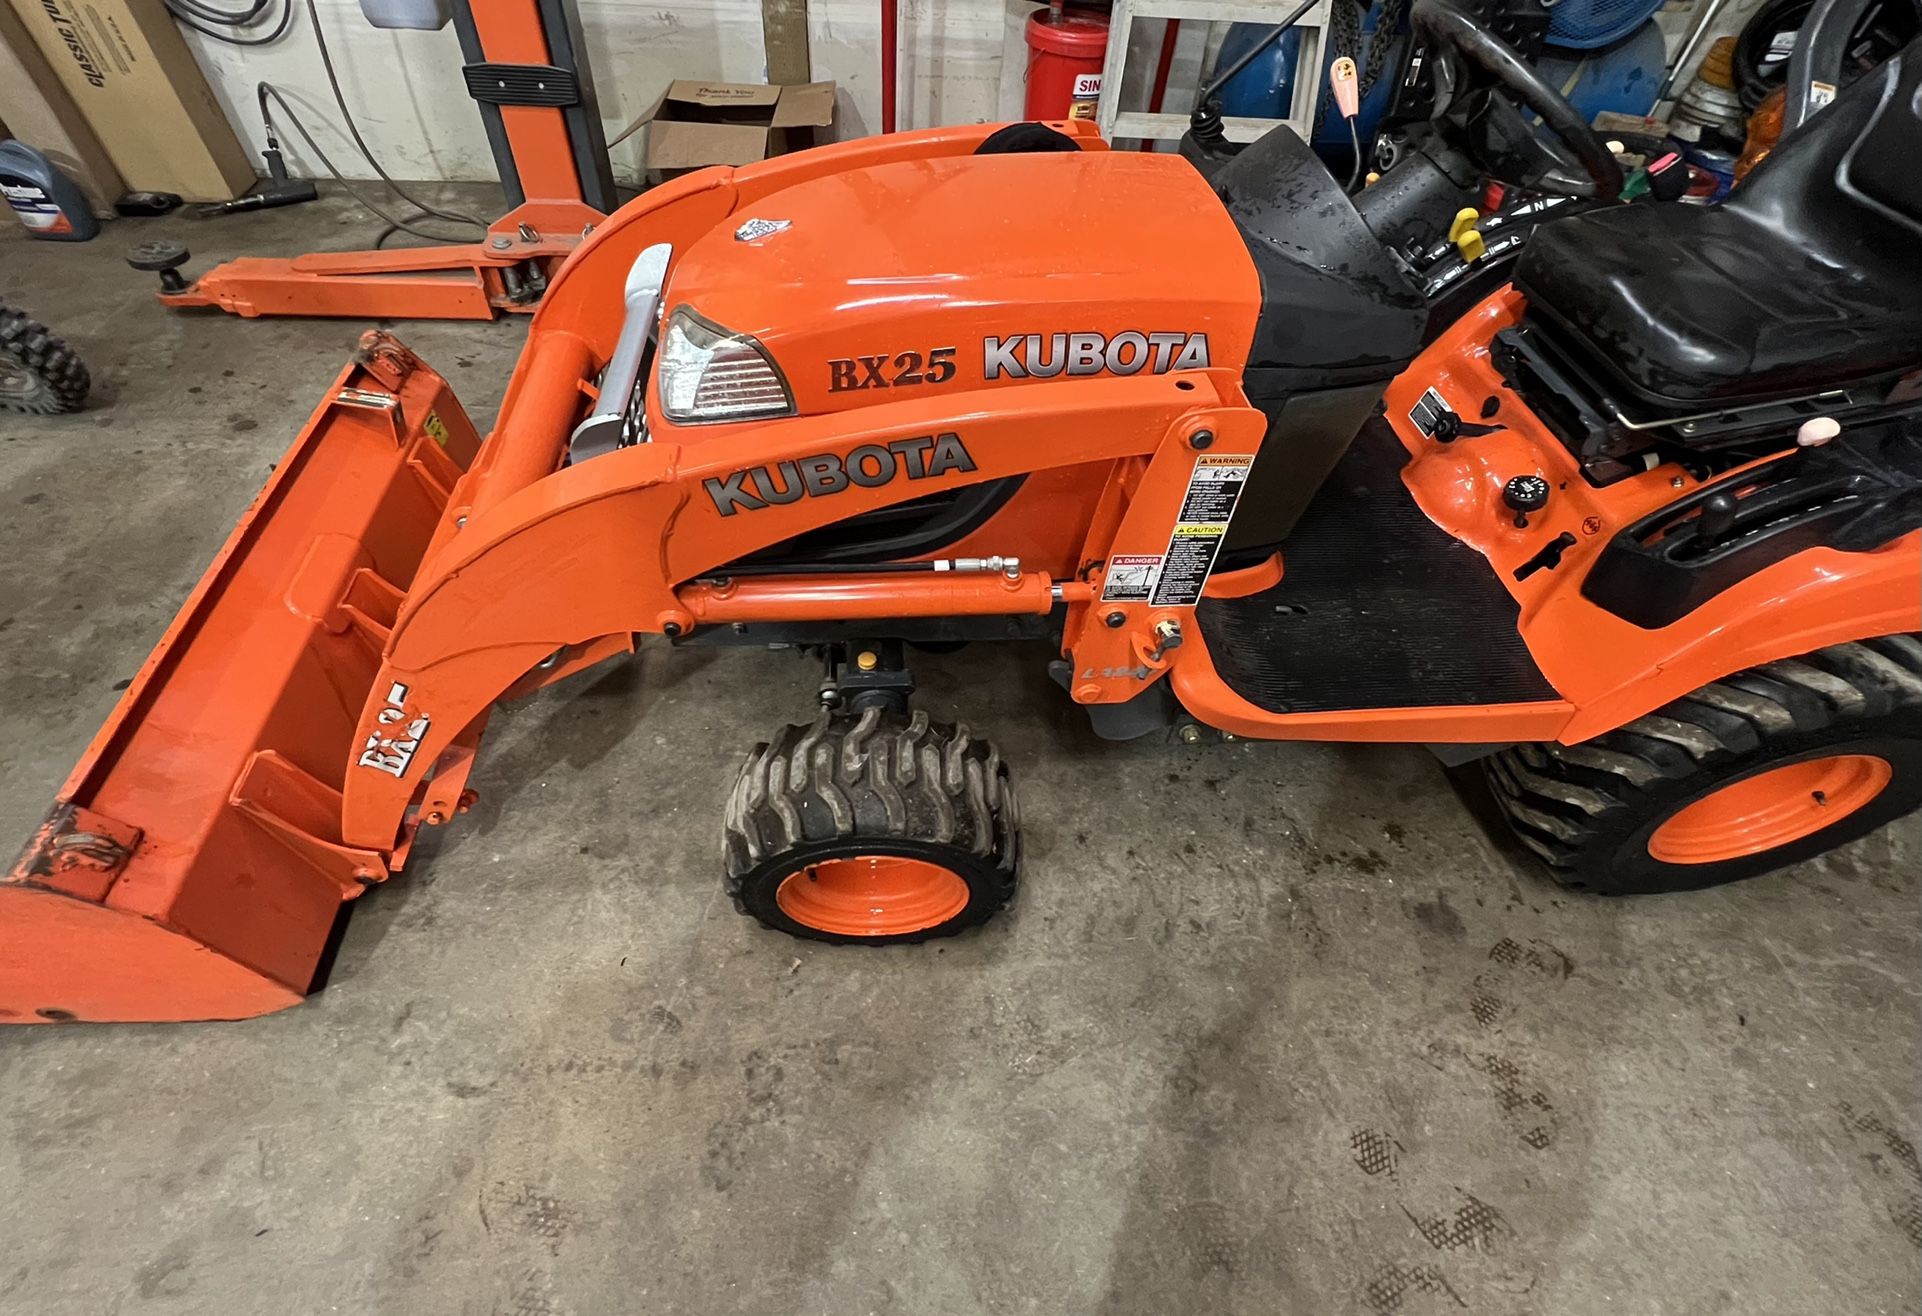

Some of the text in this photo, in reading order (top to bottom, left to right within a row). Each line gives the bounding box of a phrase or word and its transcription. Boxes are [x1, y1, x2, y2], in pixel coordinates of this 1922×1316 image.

[41, 0, 72, 24] TU
[58, 27, 105, 88] CLASSIC
[827, 331, 1212, 393] BX25 KUBOTA
[702, 432, 978, 517] KUBOTA
